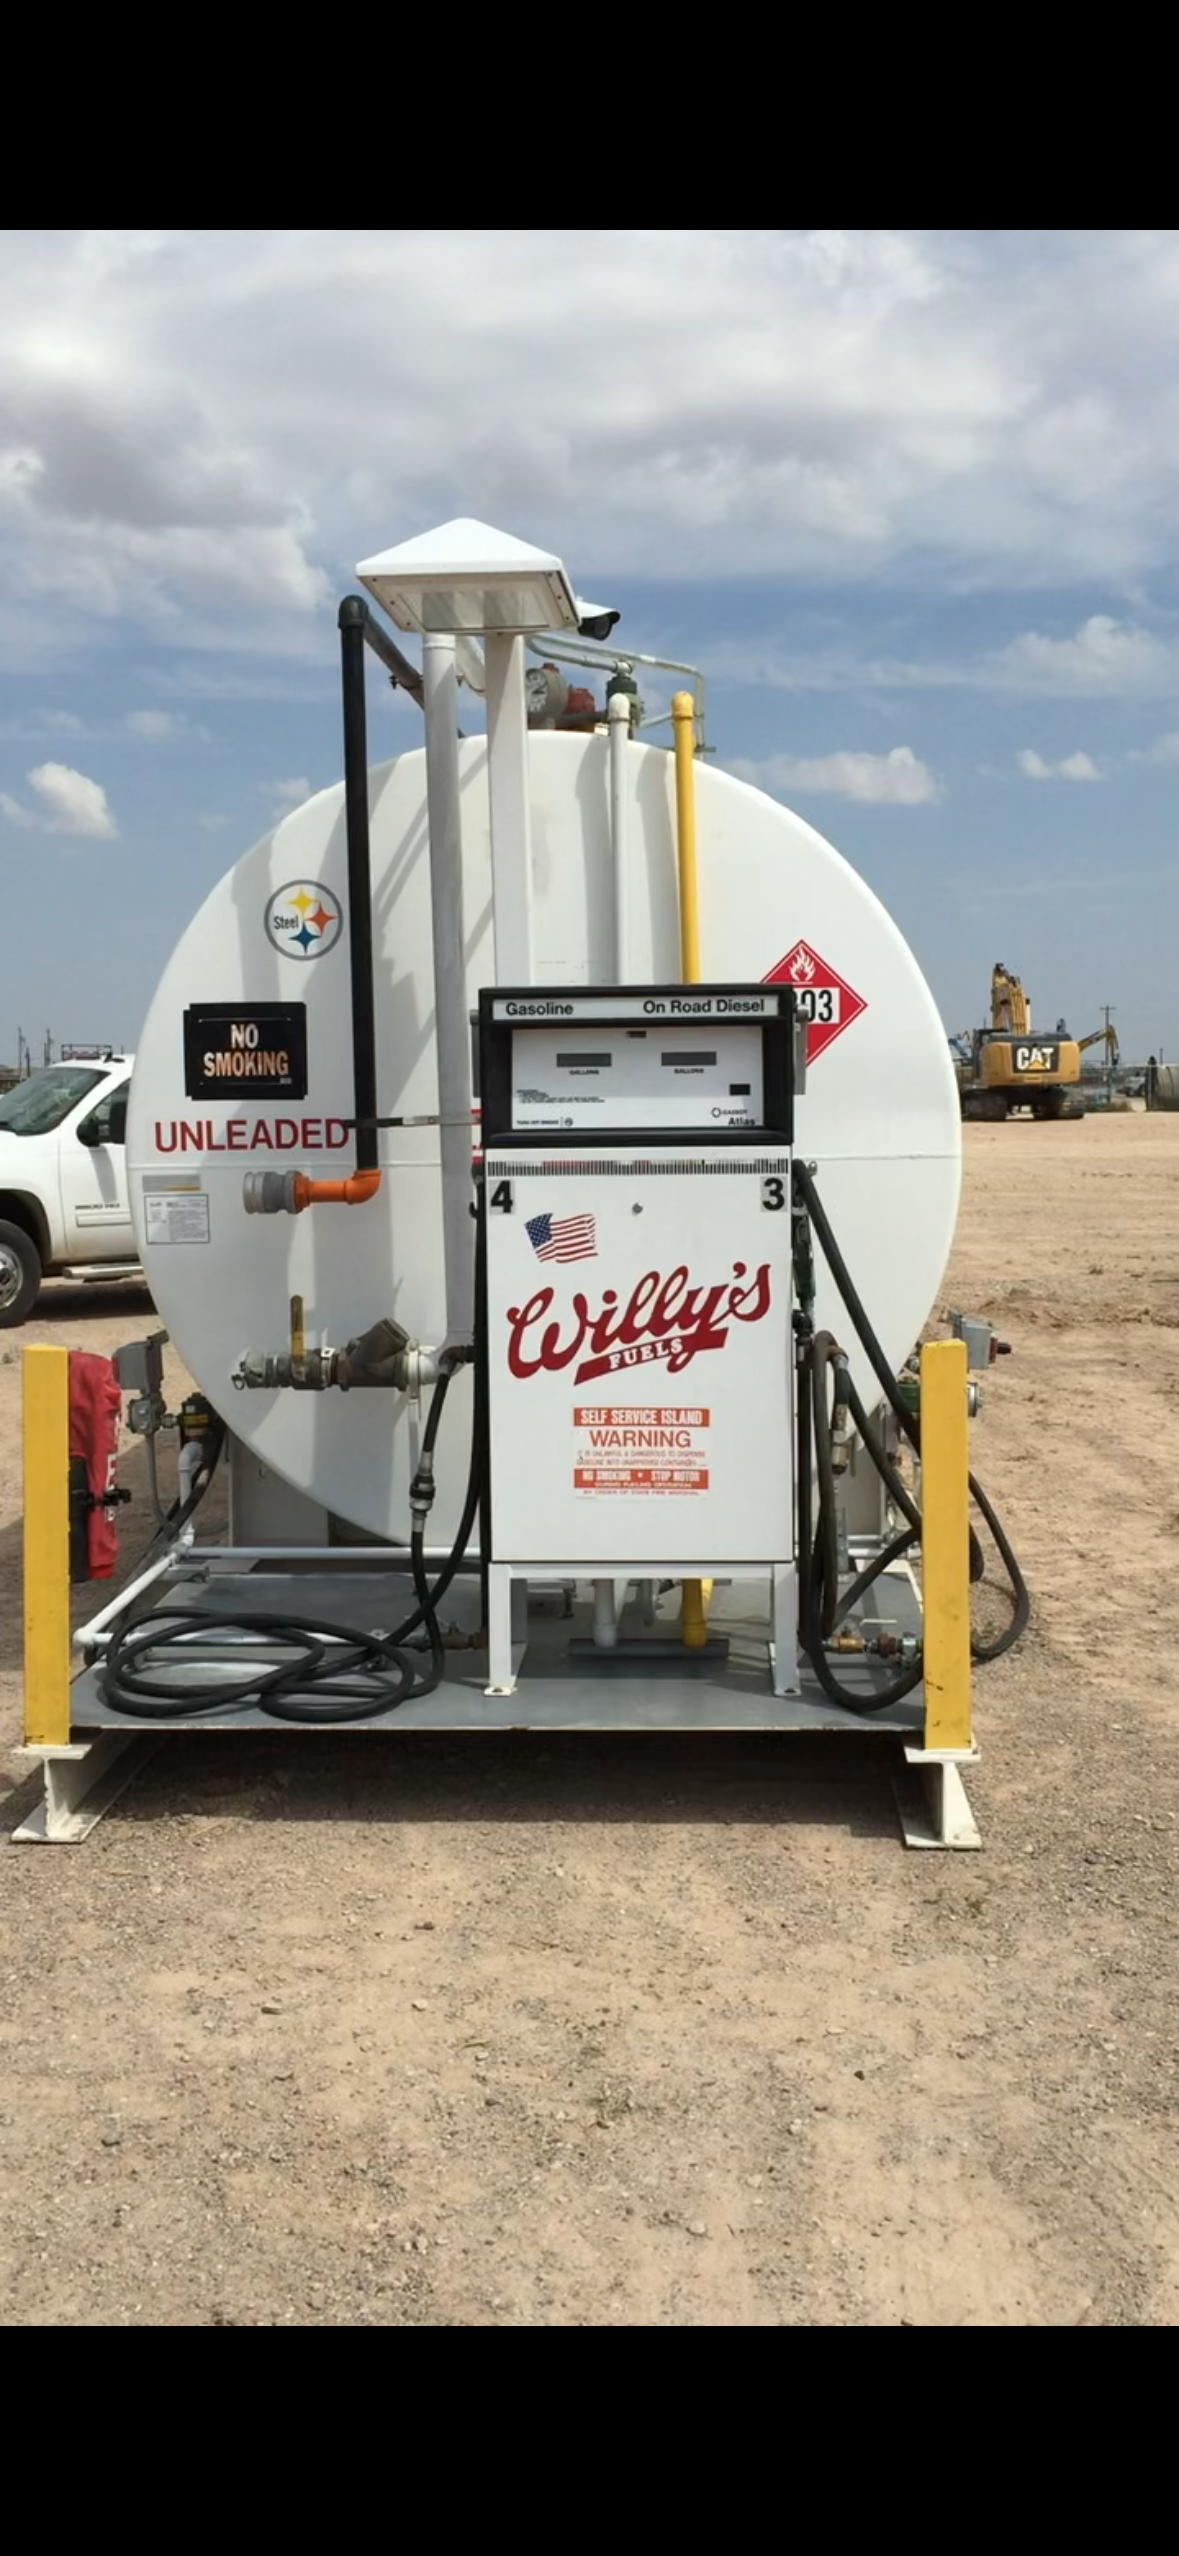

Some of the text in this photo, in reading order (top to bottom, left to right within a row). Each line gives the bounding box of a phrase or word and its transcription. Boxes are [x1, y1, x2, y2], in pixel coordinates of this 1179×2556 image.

[273, 915, 299, 930] Steel
[505, 1002, 574, 1016] Gasoline
[643, 998, 765, 1014] On Road Diesel
[793, 989, 833, 1023] 03
[230, 1023, 260, 1049] NO
[203, 1051, 289, 1077] SMOKING
[1016, 1046, 1054, 1070] CAT
[728, 1117, 756, 1126] Atlas
[154, 1118, 351, 1153] UNLEADED
[490, 1180, 514, 1214] 4
[762, 1177, 786, 1211] 3
[506, 1261, 772, 1380] Willy's
[608, 1338, 683, 1370] FUELS
[580, 1409, 703, 1425] SELF SERVICE ISLAND
[589, 1430, 691, 1448] WARNING
